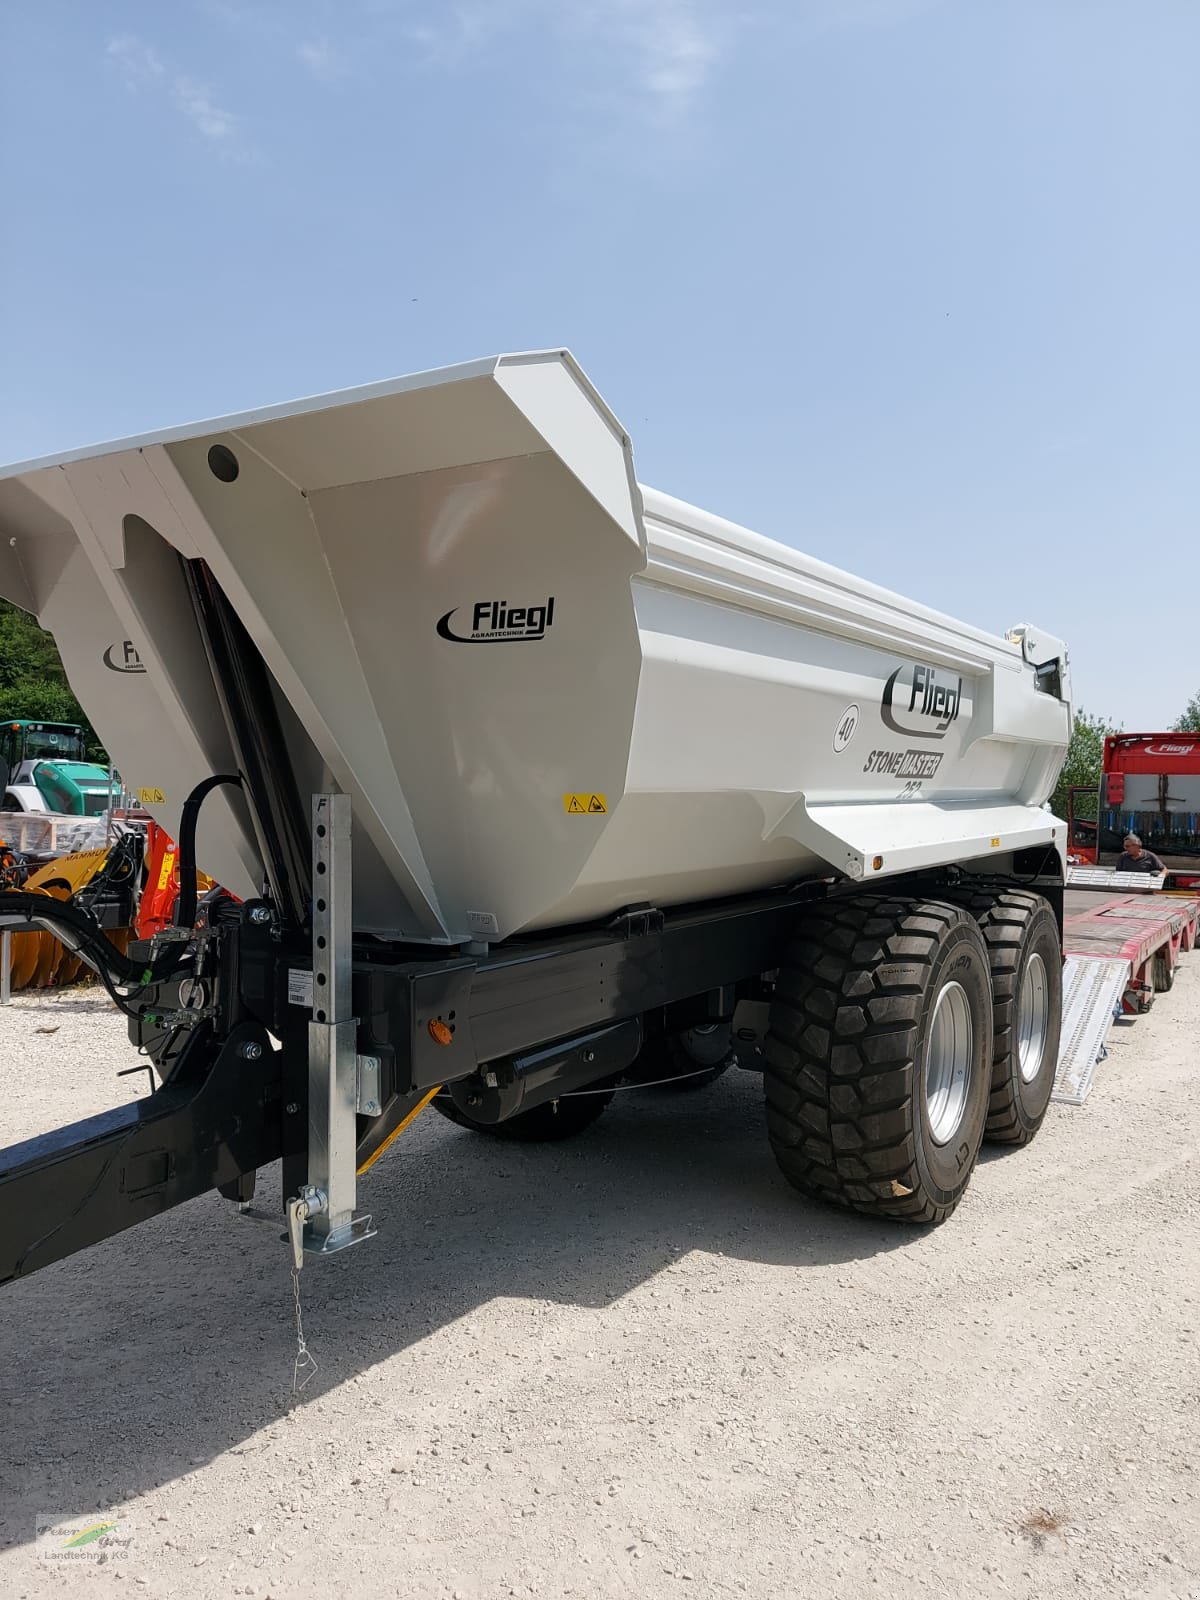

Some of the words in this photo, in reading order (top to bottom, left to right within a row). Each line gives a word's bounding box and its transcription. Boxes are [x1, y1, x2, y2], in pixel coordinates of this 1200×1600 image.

[472, 596, 555, 635] Fliegl
[470, 630, 524, 638] AGRARTECHNIK
[908, 665, 962, 731] Fliegl
[838, 717, 854, 741] 40
[862, 749, 905, 774] STONE
[1159, 744, 1194, 755] Fliegl
[897, 751, 943, 778] MASTER
